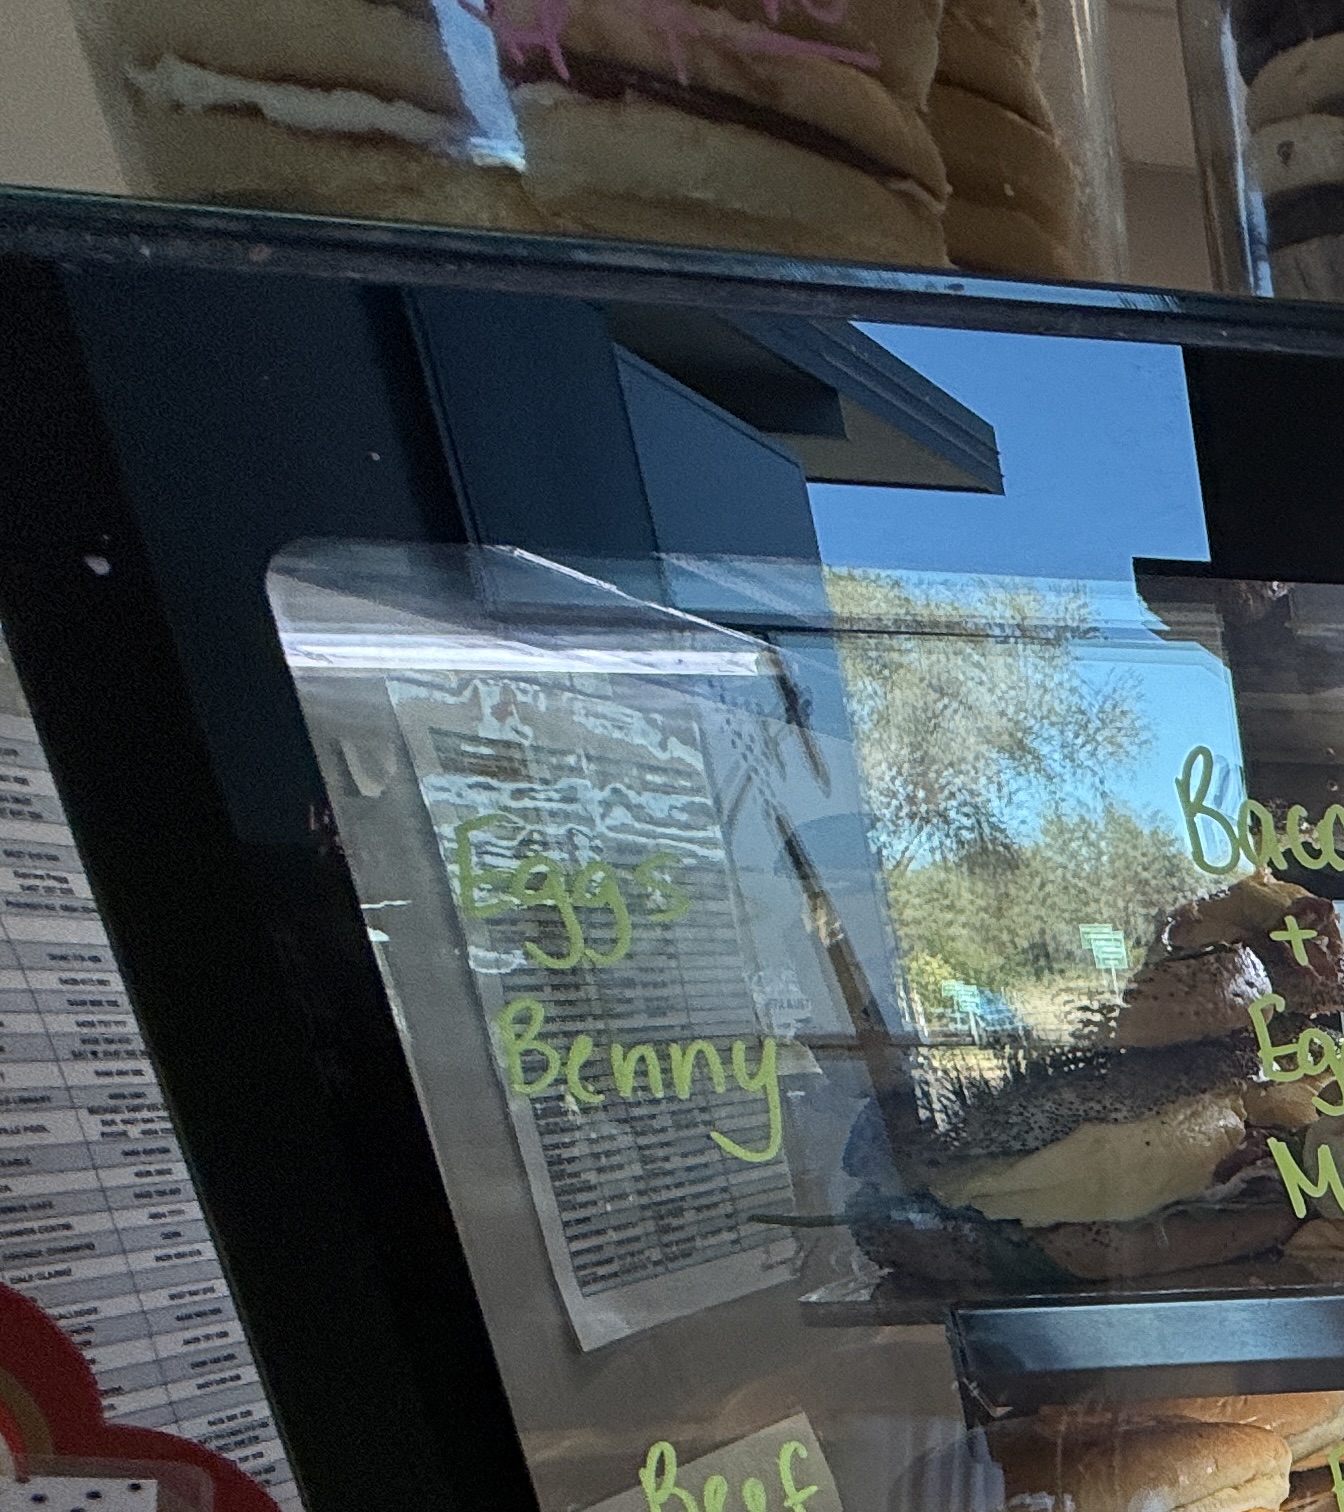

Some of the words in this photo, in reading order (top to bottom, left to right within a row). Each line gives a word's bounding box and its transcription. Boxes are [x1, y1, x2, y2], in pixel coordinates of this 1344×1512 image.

[450, 812, 689, 970] Eggs
[1271, 916, 1317, 966] +
[499, 996, 785, 1163] Benny
